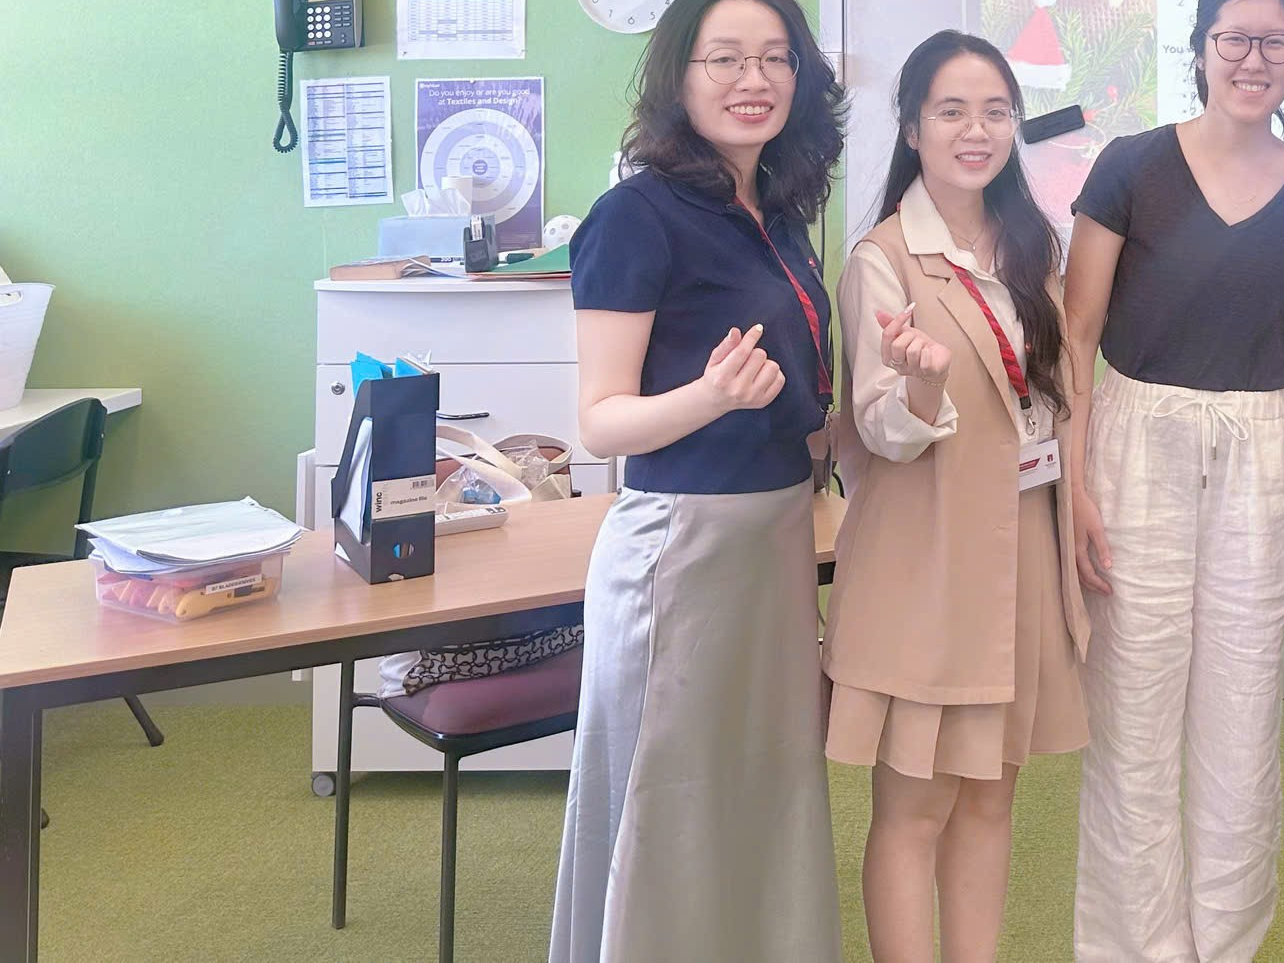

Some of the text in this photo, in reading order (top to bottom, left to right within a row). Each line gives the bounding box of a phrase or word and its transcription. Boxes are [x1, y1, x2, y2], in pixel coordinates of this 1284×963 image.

[649, 11, 656, 20] 5
[627, 16, 635, 25] 6
[1162, 45, 1184, 54] You
[429, 89, 440, 97] Do
[440, 90, 454, 98] you
[455, 89, 474, 98] enjoy
[498, 89, 511, 97] you
[512, 88, 530, 97] good
[477, 97, 492, 105] and
[374, 492, 383, 513] winc
[390, 497, 418, 505] magazine
